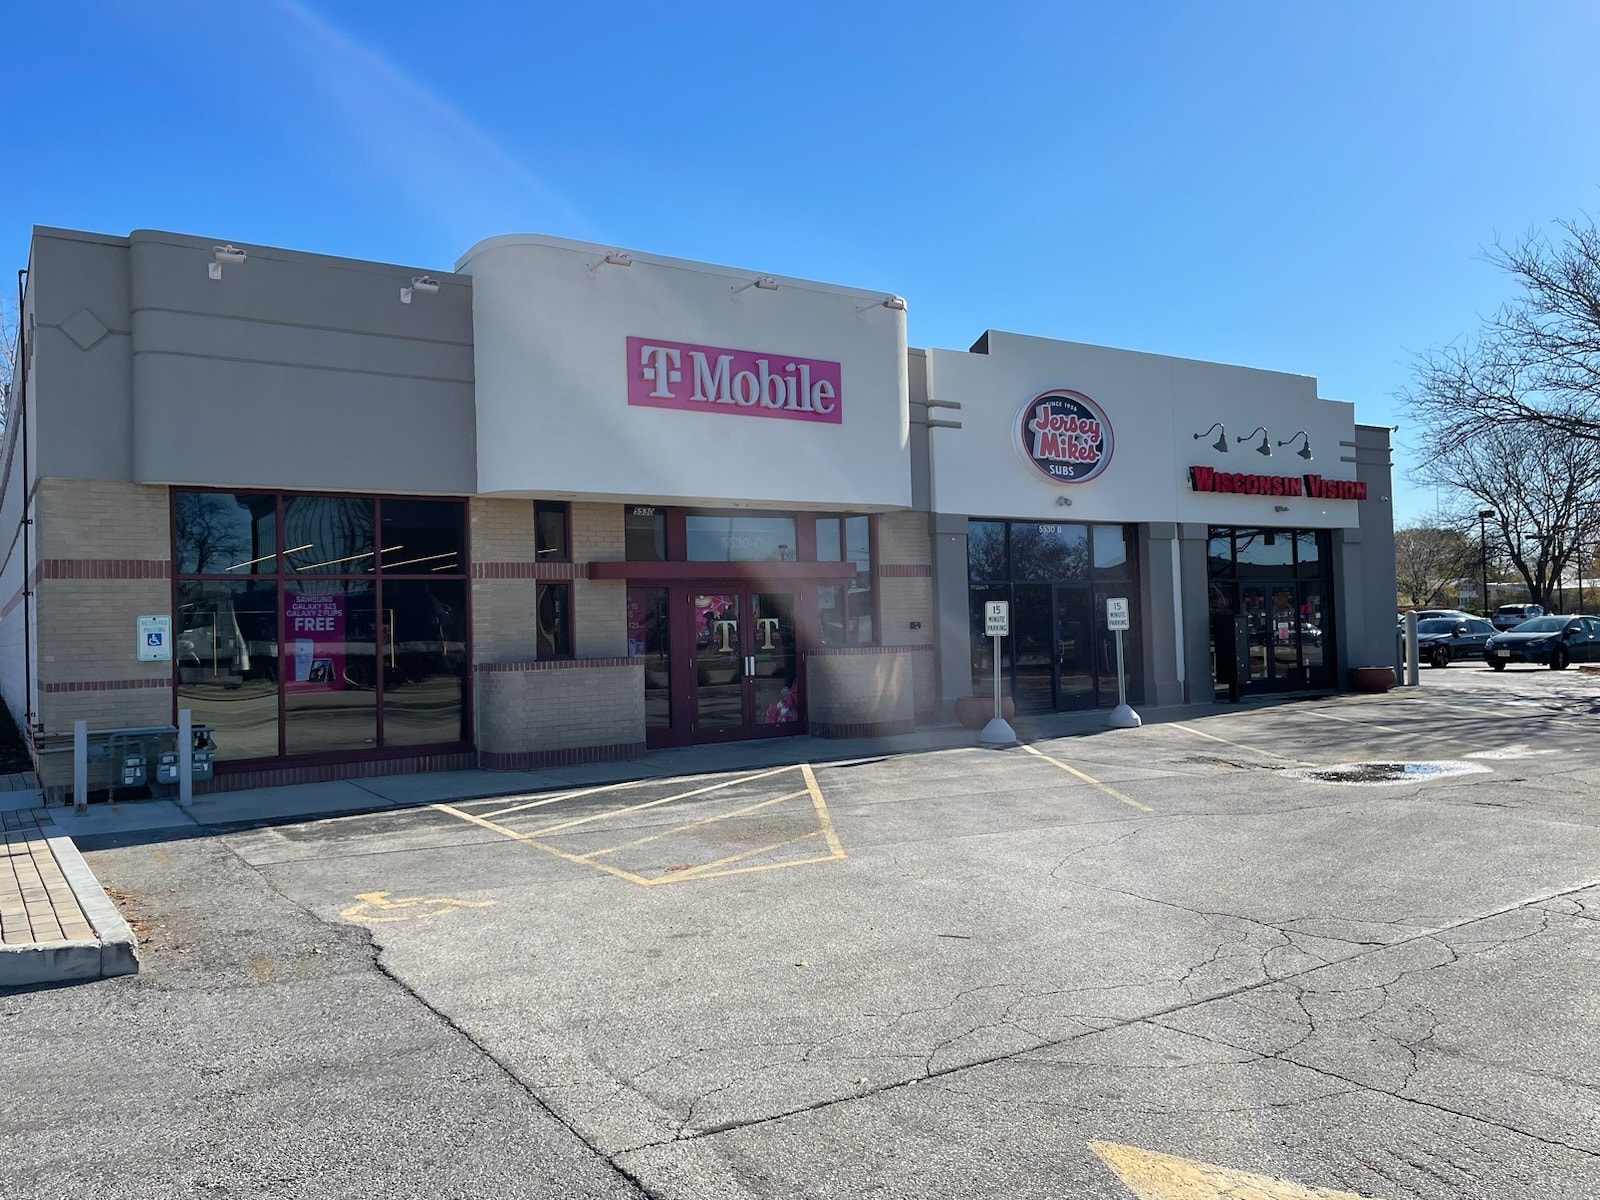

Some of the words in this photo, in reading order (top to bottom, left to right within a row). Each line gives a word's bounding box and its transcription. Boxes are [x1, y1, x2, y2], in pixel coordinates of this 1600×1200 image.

[688, 351, 836, 414] Mobile
[1064, 403, 1077, 412] 1956
[1034, 405, 1101, 444] Jersey
[1038, 431, 1101, 463] Mike's
[1049, 464, 1075, 476] SUBS
[1038, 525, 1056, 534] 5530
[992, 605, 1001, 615] 15
[1113, 602, 1122, 611] 15
[294, 617, 335, 631] FREE
[713, 620, 738, 653] T
[756, 617, 779, 650] T
